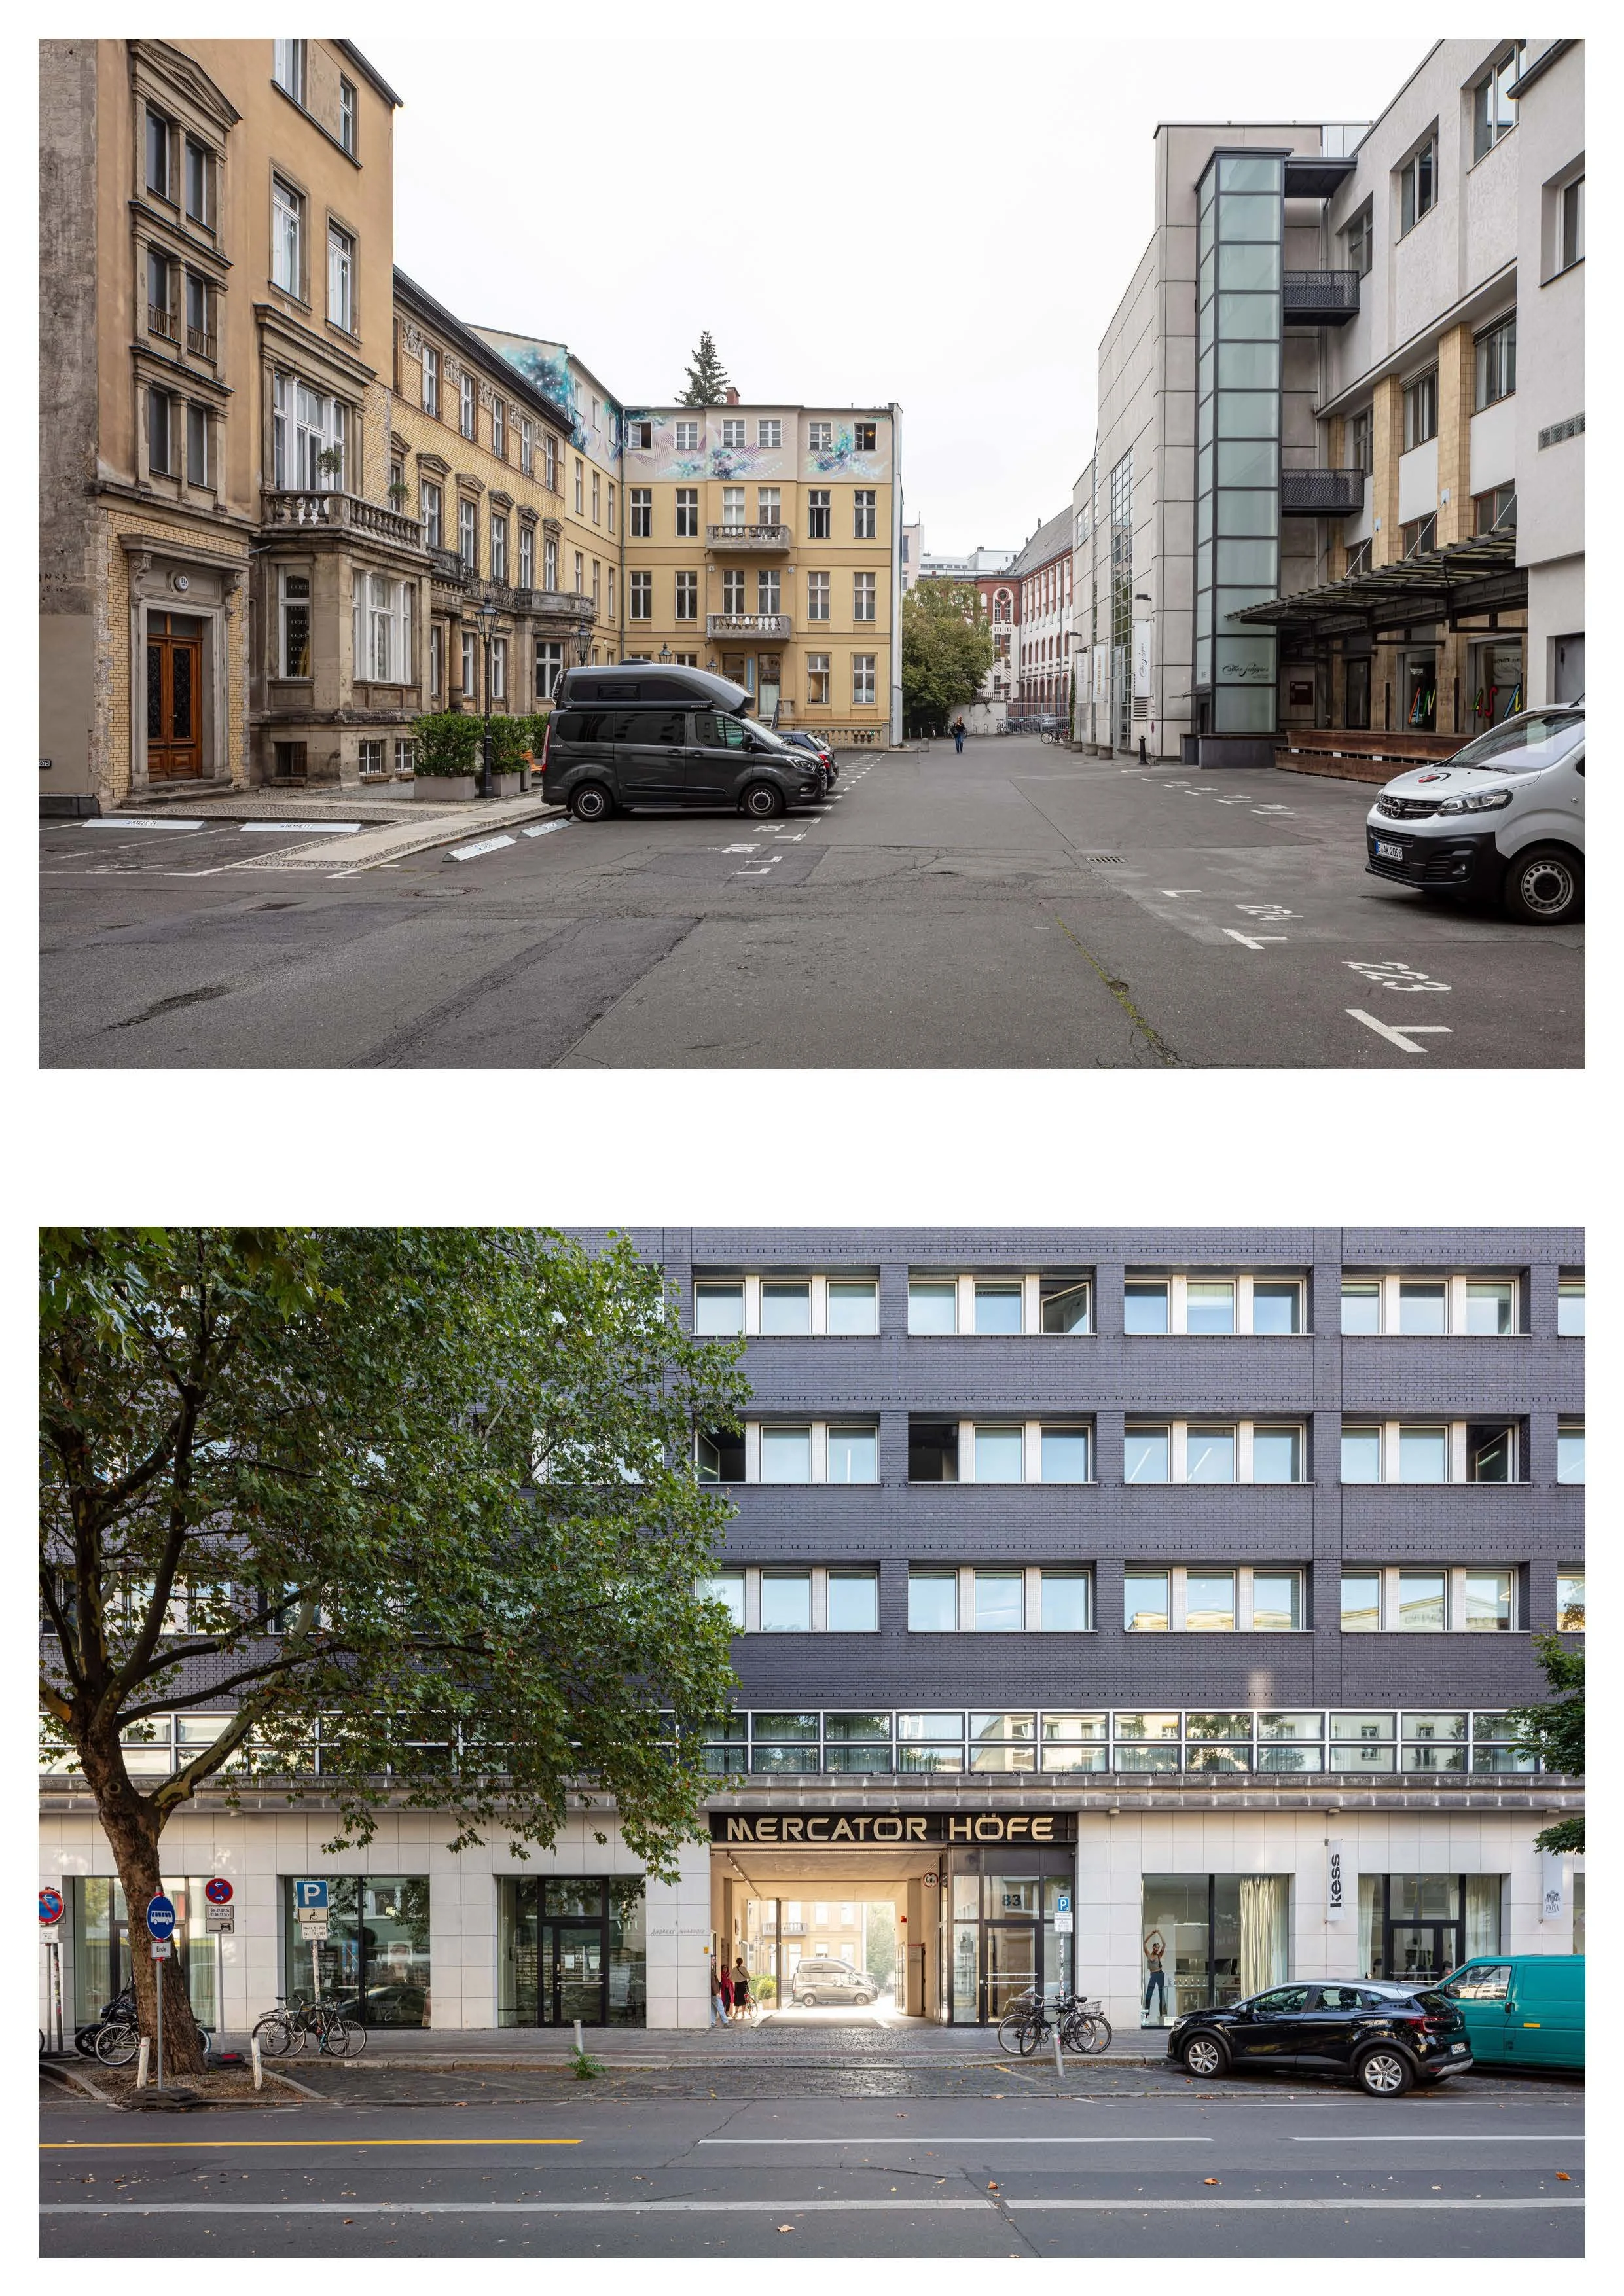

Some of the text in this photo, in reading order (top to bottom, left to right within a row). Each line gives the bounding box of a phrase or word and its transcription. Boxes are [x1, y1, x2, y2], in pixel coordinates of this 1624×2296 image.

[1235, 905, 1304, 920] 224
[1341, 961, 1452, 991] 223
[727, 1812, 1054, 1840] MERCATOR HÖFE
[1330, 1854, 1341, 1907] kess
[304, 1884, 321, 1905] P
[1001, 1894, 1021, 1906] 83
[1060, 1899, 1067, 1910] P
